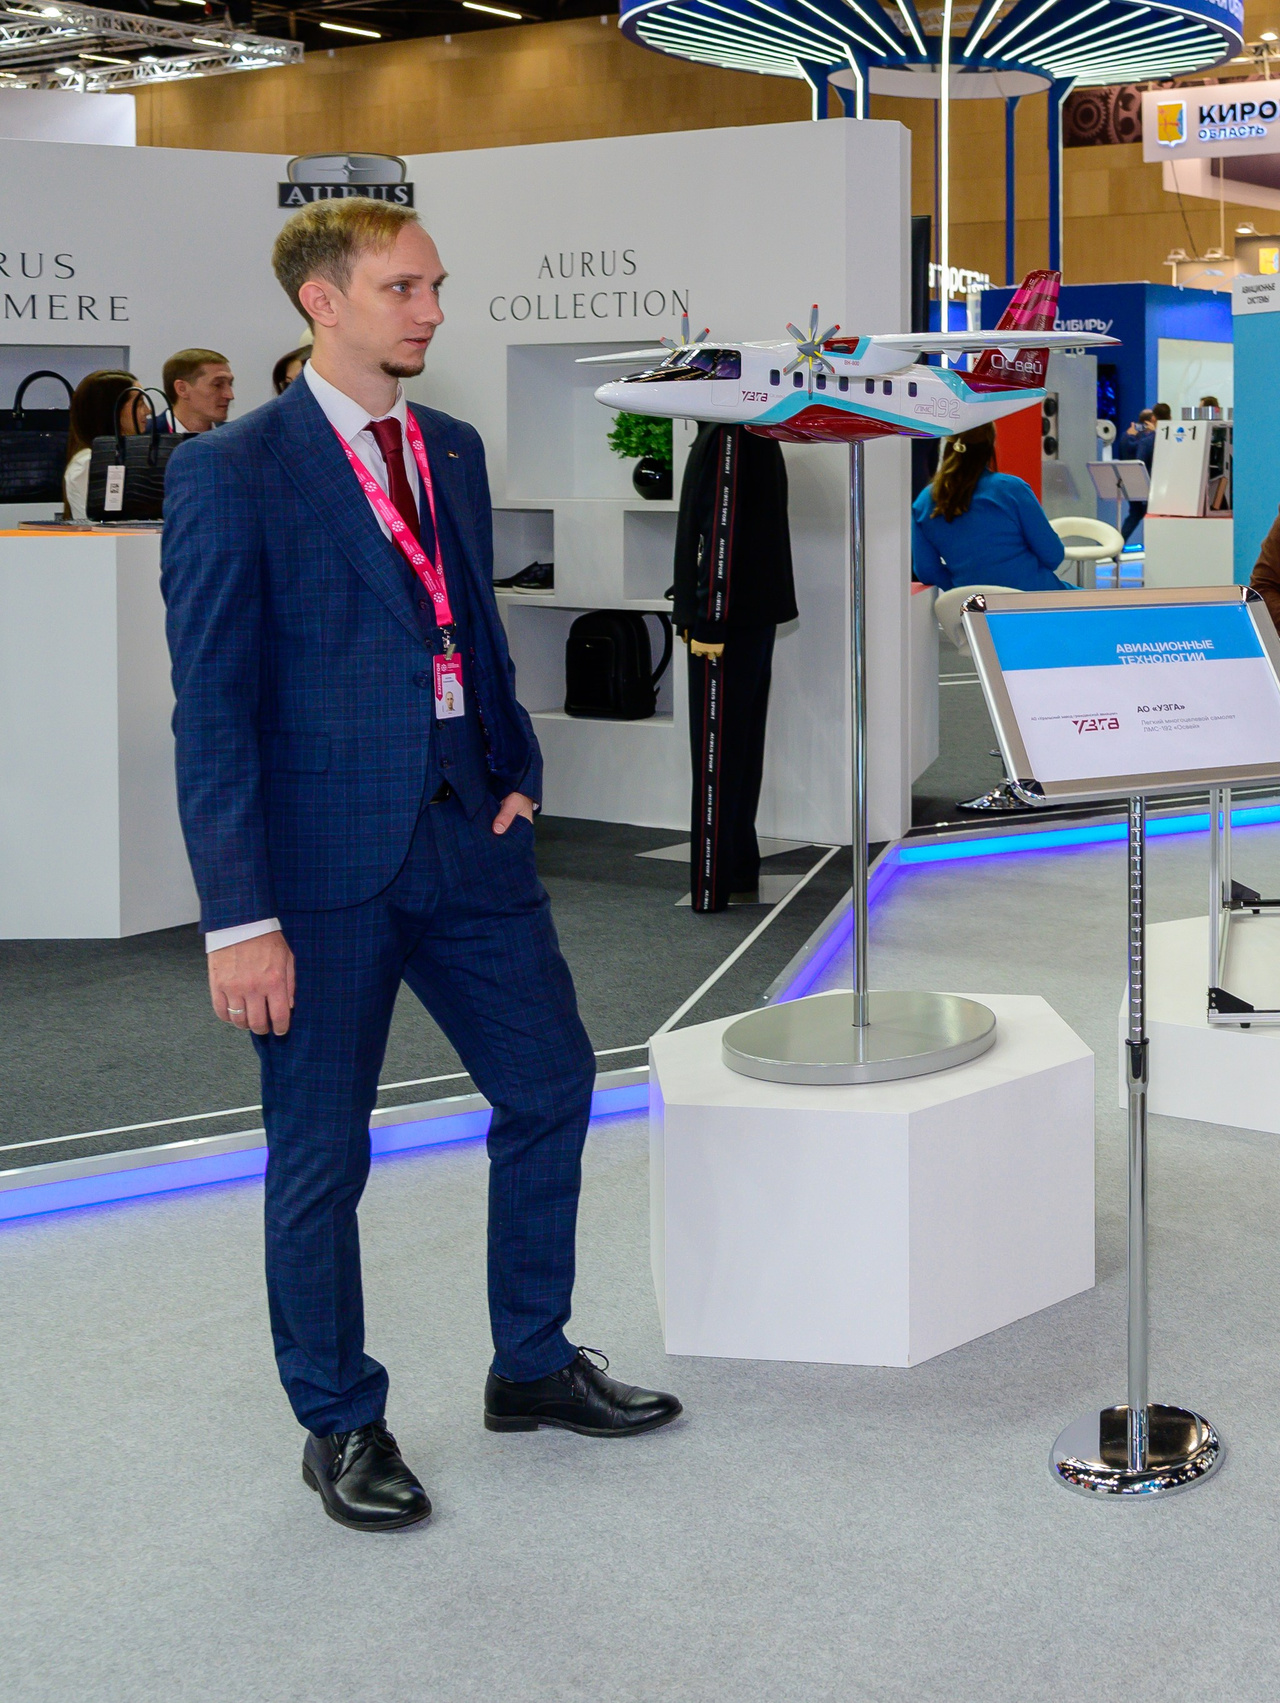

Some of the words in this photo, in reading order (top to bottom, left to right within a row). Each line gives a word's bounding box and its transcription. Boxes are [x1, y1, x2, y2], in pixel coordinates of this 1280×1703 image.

[1199, 126, 1266, 141] ОБЛАСТЬ
[284, 186, 409, 204] AURUS
[538, 249, 637, 279] AURUS
[4, 293, 130, 322] MERE
[489, 289, 690, 322] COLLECTION
[991, 354, 1042, 374] Освей
[930, 397, 960, 418] 192
[1116, 640, 1214, 654] АВИАЦИОННЫЕ
[1118, 652, 1206, 666] ТЕХНОЛОГИИ
[1137, 705, 1150, 713] АО
[1152, 704, 1186, 712] «УЗГА»
